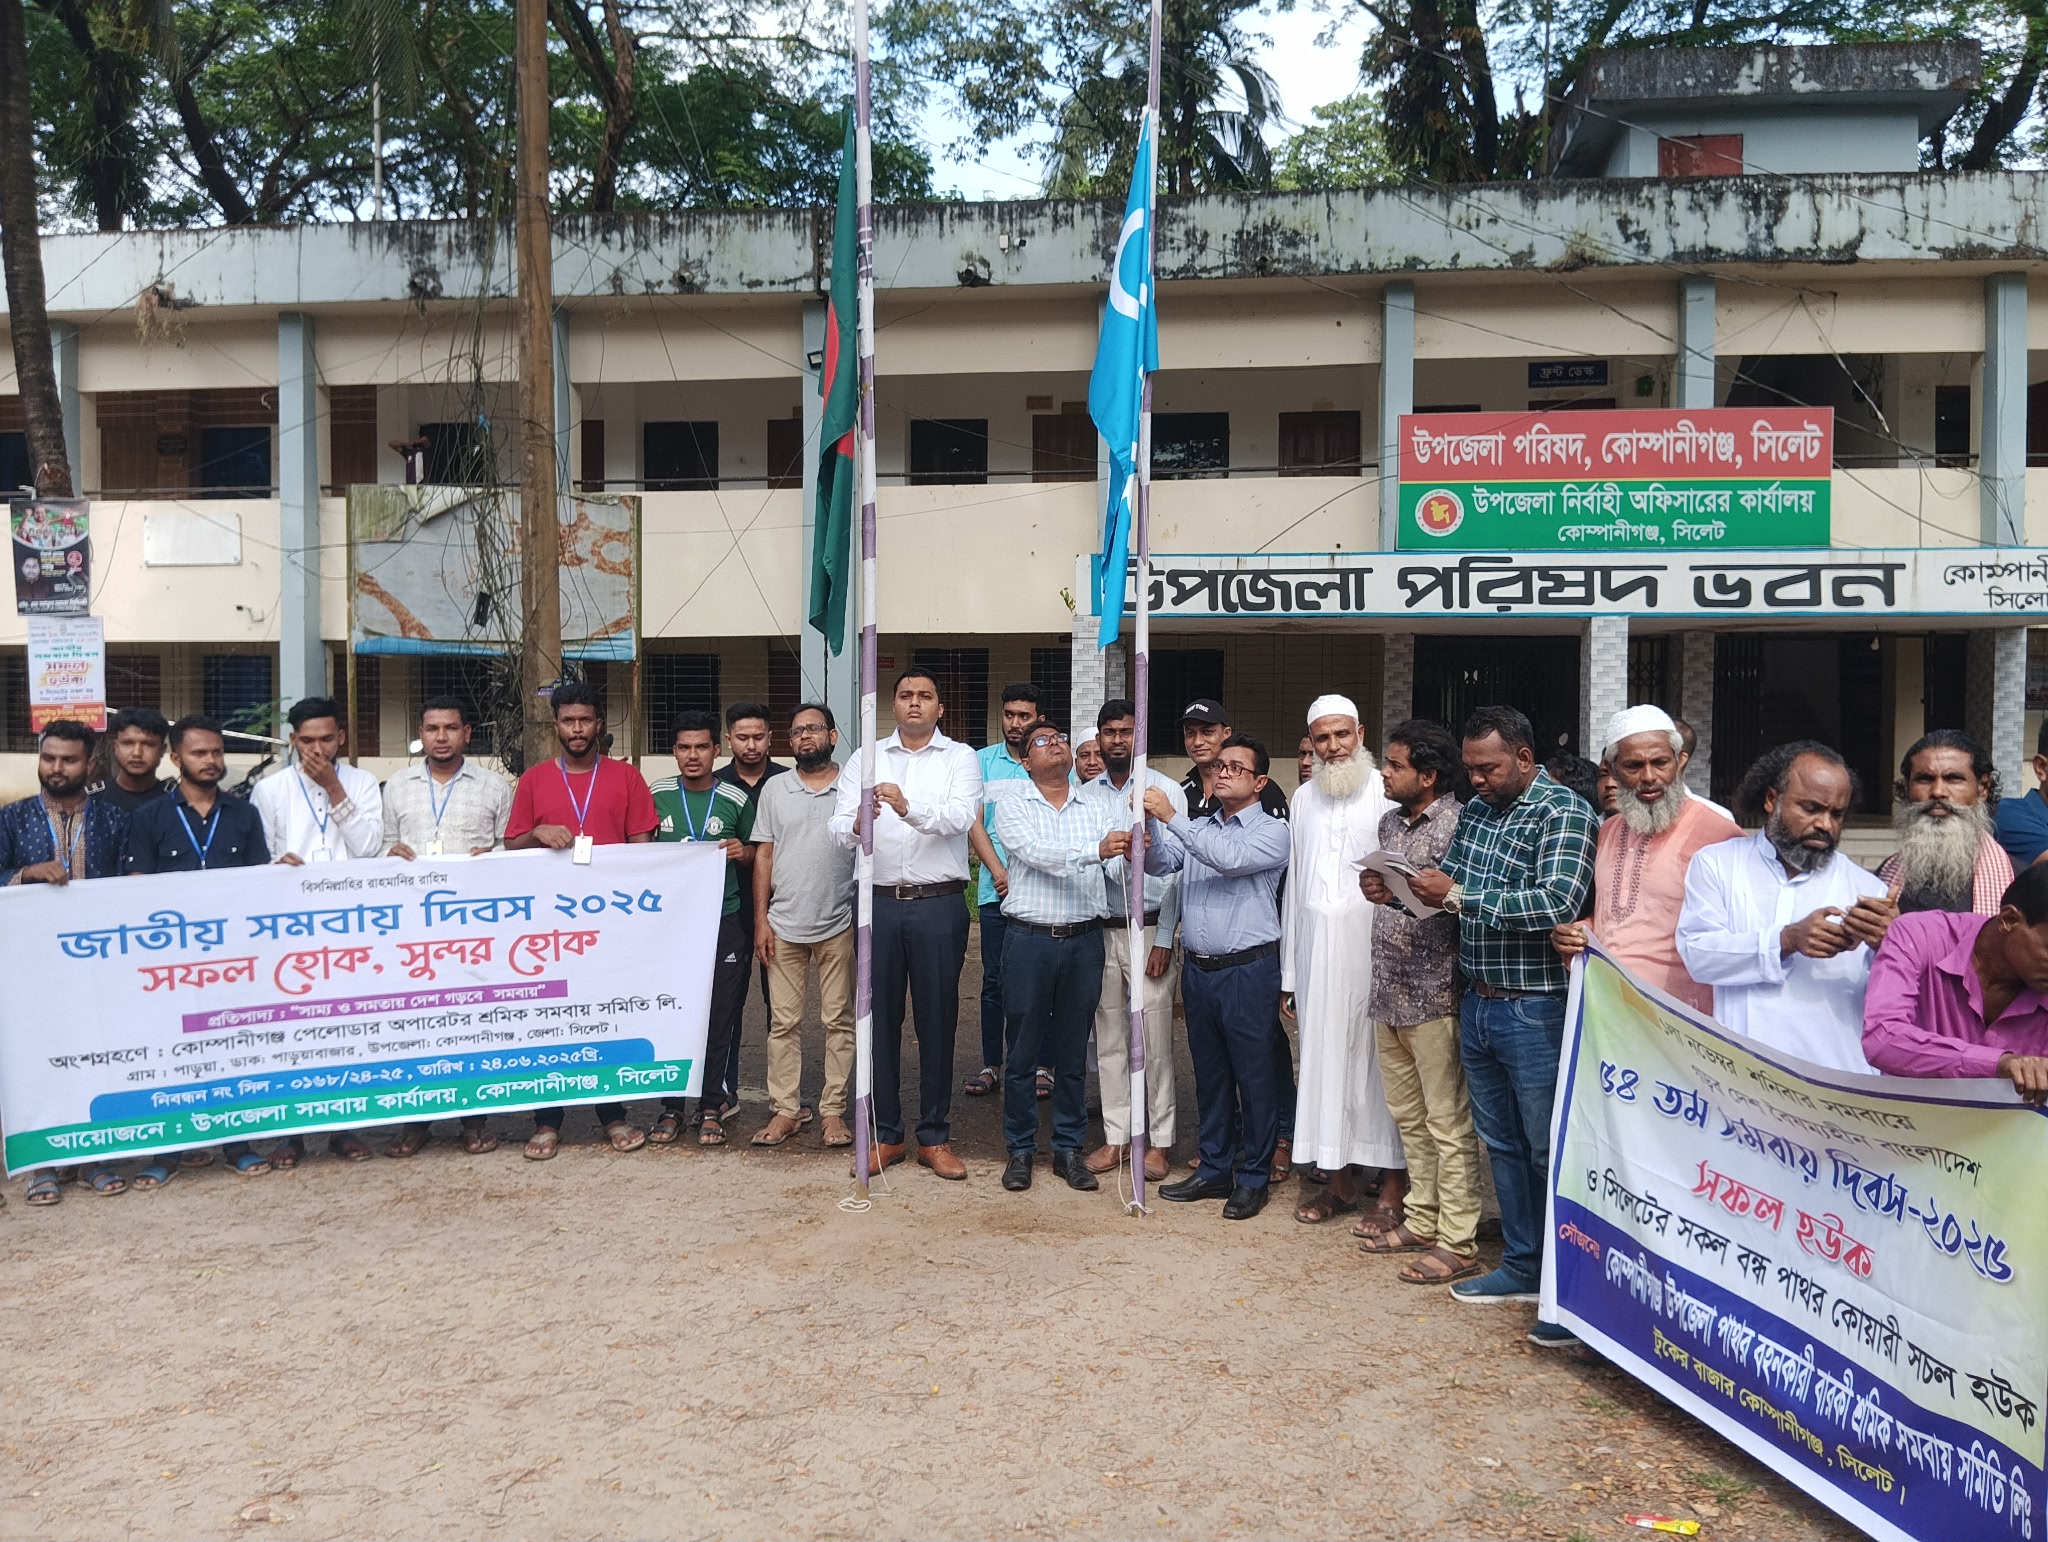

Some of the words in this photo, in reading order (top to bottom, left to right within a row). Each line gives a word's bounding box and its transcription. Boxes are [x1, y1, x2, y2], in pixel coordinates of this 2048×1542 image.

[1411, 425, 1506, 466] উপজেলা
[1512, 422, 1592, 471] পরিষদ,
[1601, 419, 1743, 470] কোম্পানীগঞ্জ,
[1750, 419, 1824, 464] সিলেট
[1471, 485, 1555, 516] উপজেলা
[1562, 483, 1623, 516] নির্বাহী
[1628, 484, 1732, 515] অফিসারের
[1738, 481, 1816, 515] কার্যালয়
[1558, 519, 1666, 545] কোম্পানীগঞ্জ,
[1672, 519, 1726, 542] সিলেট
[1122, 558, 1373, 613] উপজেলা
[1397, 557, 1668, 613] পরিষদ
[1690, 563, 1906, 608] ভবন
[1983, 585, 2048, 610] সিলে
[366, 873, 415, 889] রাহমানির
[418, 871, 448, 885] রাহিম
[57, 910, 228, 960] জাতীয়
[246, 902, 403, 940] সমবায়
[420, 890, 535, 927] দিবস
[554, 888, 663, 918] ২০২৫
[138, 956, 259, 992] সফল
[273, 946, 384, 995] হোক,
[396, 936, 495, 981] সুন্দর
[508, 929, 601, 976] হোক
[338, 1003, 351, 1013] ও
[409, 993, 440, 1008] দেশ
[569, 1020, 609, 1036] সিলেট
[48, 1045, 149, 1070] অংশগ্রহণে
[172, 1027, 286, 1058] কোম্পানীগঞ্জ
[293, 1021, 381, 1042] পেলোডার
[387, 1010, 473, 1032] অপারেটর
[478, 1006, 529, 1025] শ্রমিক
[535, 1003, 591, 1021] সমবায়
[597, 998, 650, 1016] সমিতি
[657, 994, 682, 1012] লি.
[46, 1121, 165, 1151] আয়োজনে
[190, 1103, 288, 1132] উপজেলা
[296, 1096, 368, 1118] সমবায়
[616, 1064, 681, 1088] সিলেট
[151, 1091, 207, 1109] নিবন্ধন
[213, 1087, 234, 1100] নং
[417, 1059, 464, 1076] তারিখ
[1746, 1066, 1817, 1110] শনিবার
[1600, 1059, 1640, 1101] ৫৪
[1653, 1080, 1710, 1129] তম
[1717, 1106, 1819, 1183] সমবায়
[1872, 1138, 1983, 1187] বাংলাদেশ
[1691, 1159, 1786, 1232] সফল
[1795, 1208, 1876, 1277] হউক
[1587, 1168, 1598, 1192] ও
[1602, 1167, 1673, 1238] সিলেটের
[1677, 1215, 1732, 1266] সকল
[1737, 1243, 1772, 1287] বন্ধ
[1777, 1266, 1828, 1319] পাথর
[1831, 1298, 1903, 1366] কোয়ারী
[1907, 1339, 1958, 1400] সচল
[1965, 1368, 2039, 1434] হউক
[1605, 1246, 1664, 1316] কোম্পানীগঞ্জ
[1664, 1270, 1719, 1348] উপজেলা
[1718, 1312, 1757, 1368] পাথর
[1753, 1333, 1815, 1404] বহনকারী
[1814, 1368, 1854, 1430] বারকী
[1852, 1387, 1894, 1454] শ্রমিক
[1895, 1420, 1954, 1487] সমবায়
[1957, 1440, 2007, 1514] সমিতি
[1653, 1325, 1690, 1370] টুকের
[1692, 1356, 1736, 1399] বাজার
[1836, 1444, 1895, 1494] সিলেট
